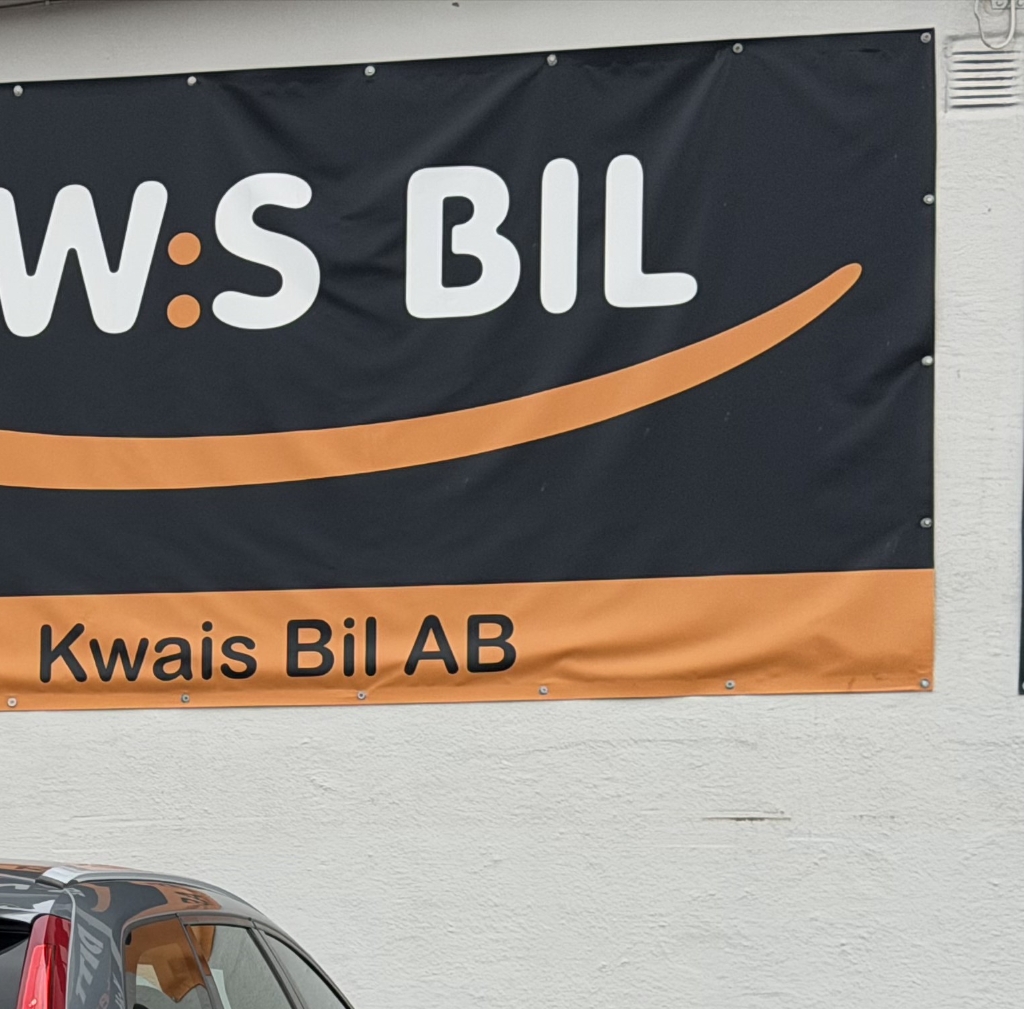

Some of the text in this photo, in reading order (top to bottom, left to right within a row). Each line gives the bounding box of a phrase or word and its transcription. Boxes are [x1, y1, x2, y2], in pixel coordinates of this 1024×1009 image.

[406, 155, 698, 319] BIL
[40, 614, 517, 683] Kwais Bil AB
